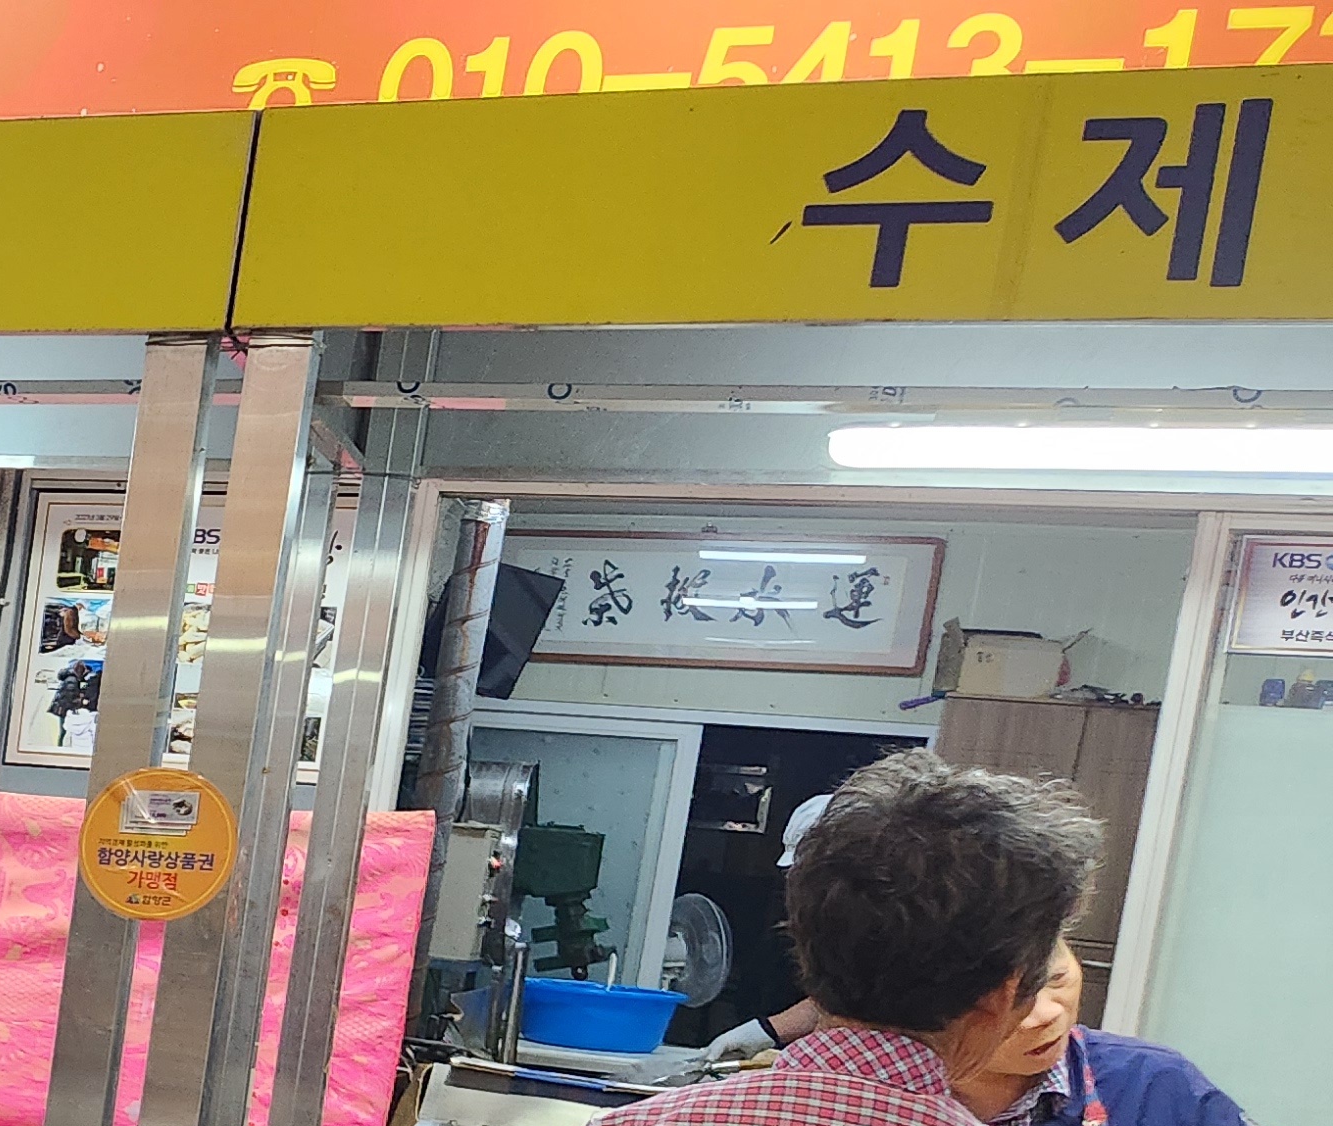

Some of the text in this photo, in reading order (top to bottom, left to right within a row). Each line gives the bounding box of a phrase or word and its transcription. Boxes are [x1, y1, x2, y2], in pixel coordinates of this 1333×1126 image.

[377, 4, 1333, 102] 010-5413-17
[800, 97, 1275, 289] 수제
[192, 528, 222, 545] BS
[1272, 552, 1323, 569] KBS
[97, 847, 215, 871] 함양사랑상품권
[126, 870, 178, 891] 가맹점
